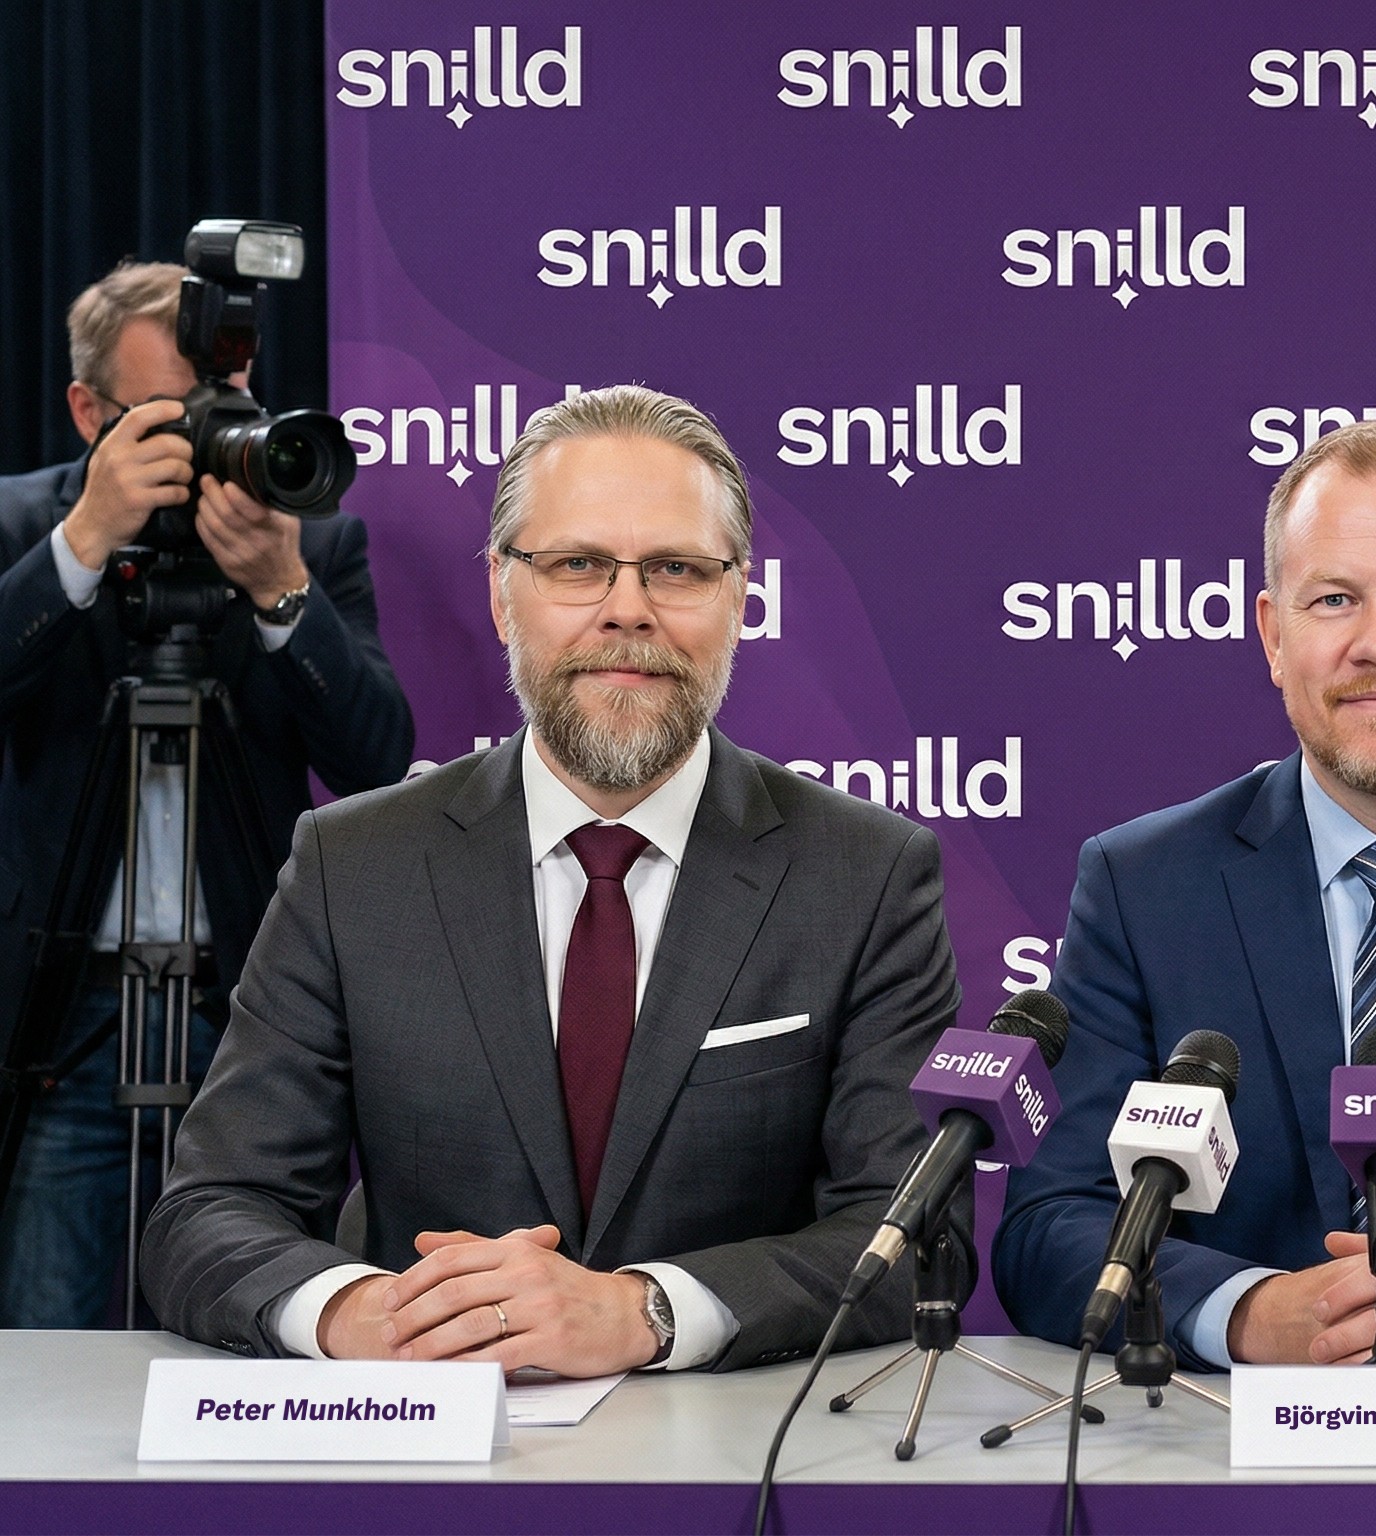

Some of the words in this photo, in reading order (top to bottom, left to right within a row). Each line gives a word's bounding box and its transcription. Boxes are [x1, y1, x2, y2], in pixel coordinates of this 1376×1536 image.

[336, 26, 581, 108] snilld
[777, 26, 1022, 108] snilld
[537, 206, 781, 287] snilld
[1001, 206, 1245, 287] snilld
[339, 384, 582, 466] snill
[776, 384, 1022, 466] snilld
[1001, 558, 1245, 640] snilld
[783, 736, 1022, 819] nilld
[931, 1051, 1013, 1078] snilld
[1015, 1073, 1049, 1138] snilld
[1126, 1105, 1203, 1129] snilld
[196, 1398, 275, 1421] Peter
[282, 1397, 436, 1421] Munkholm
